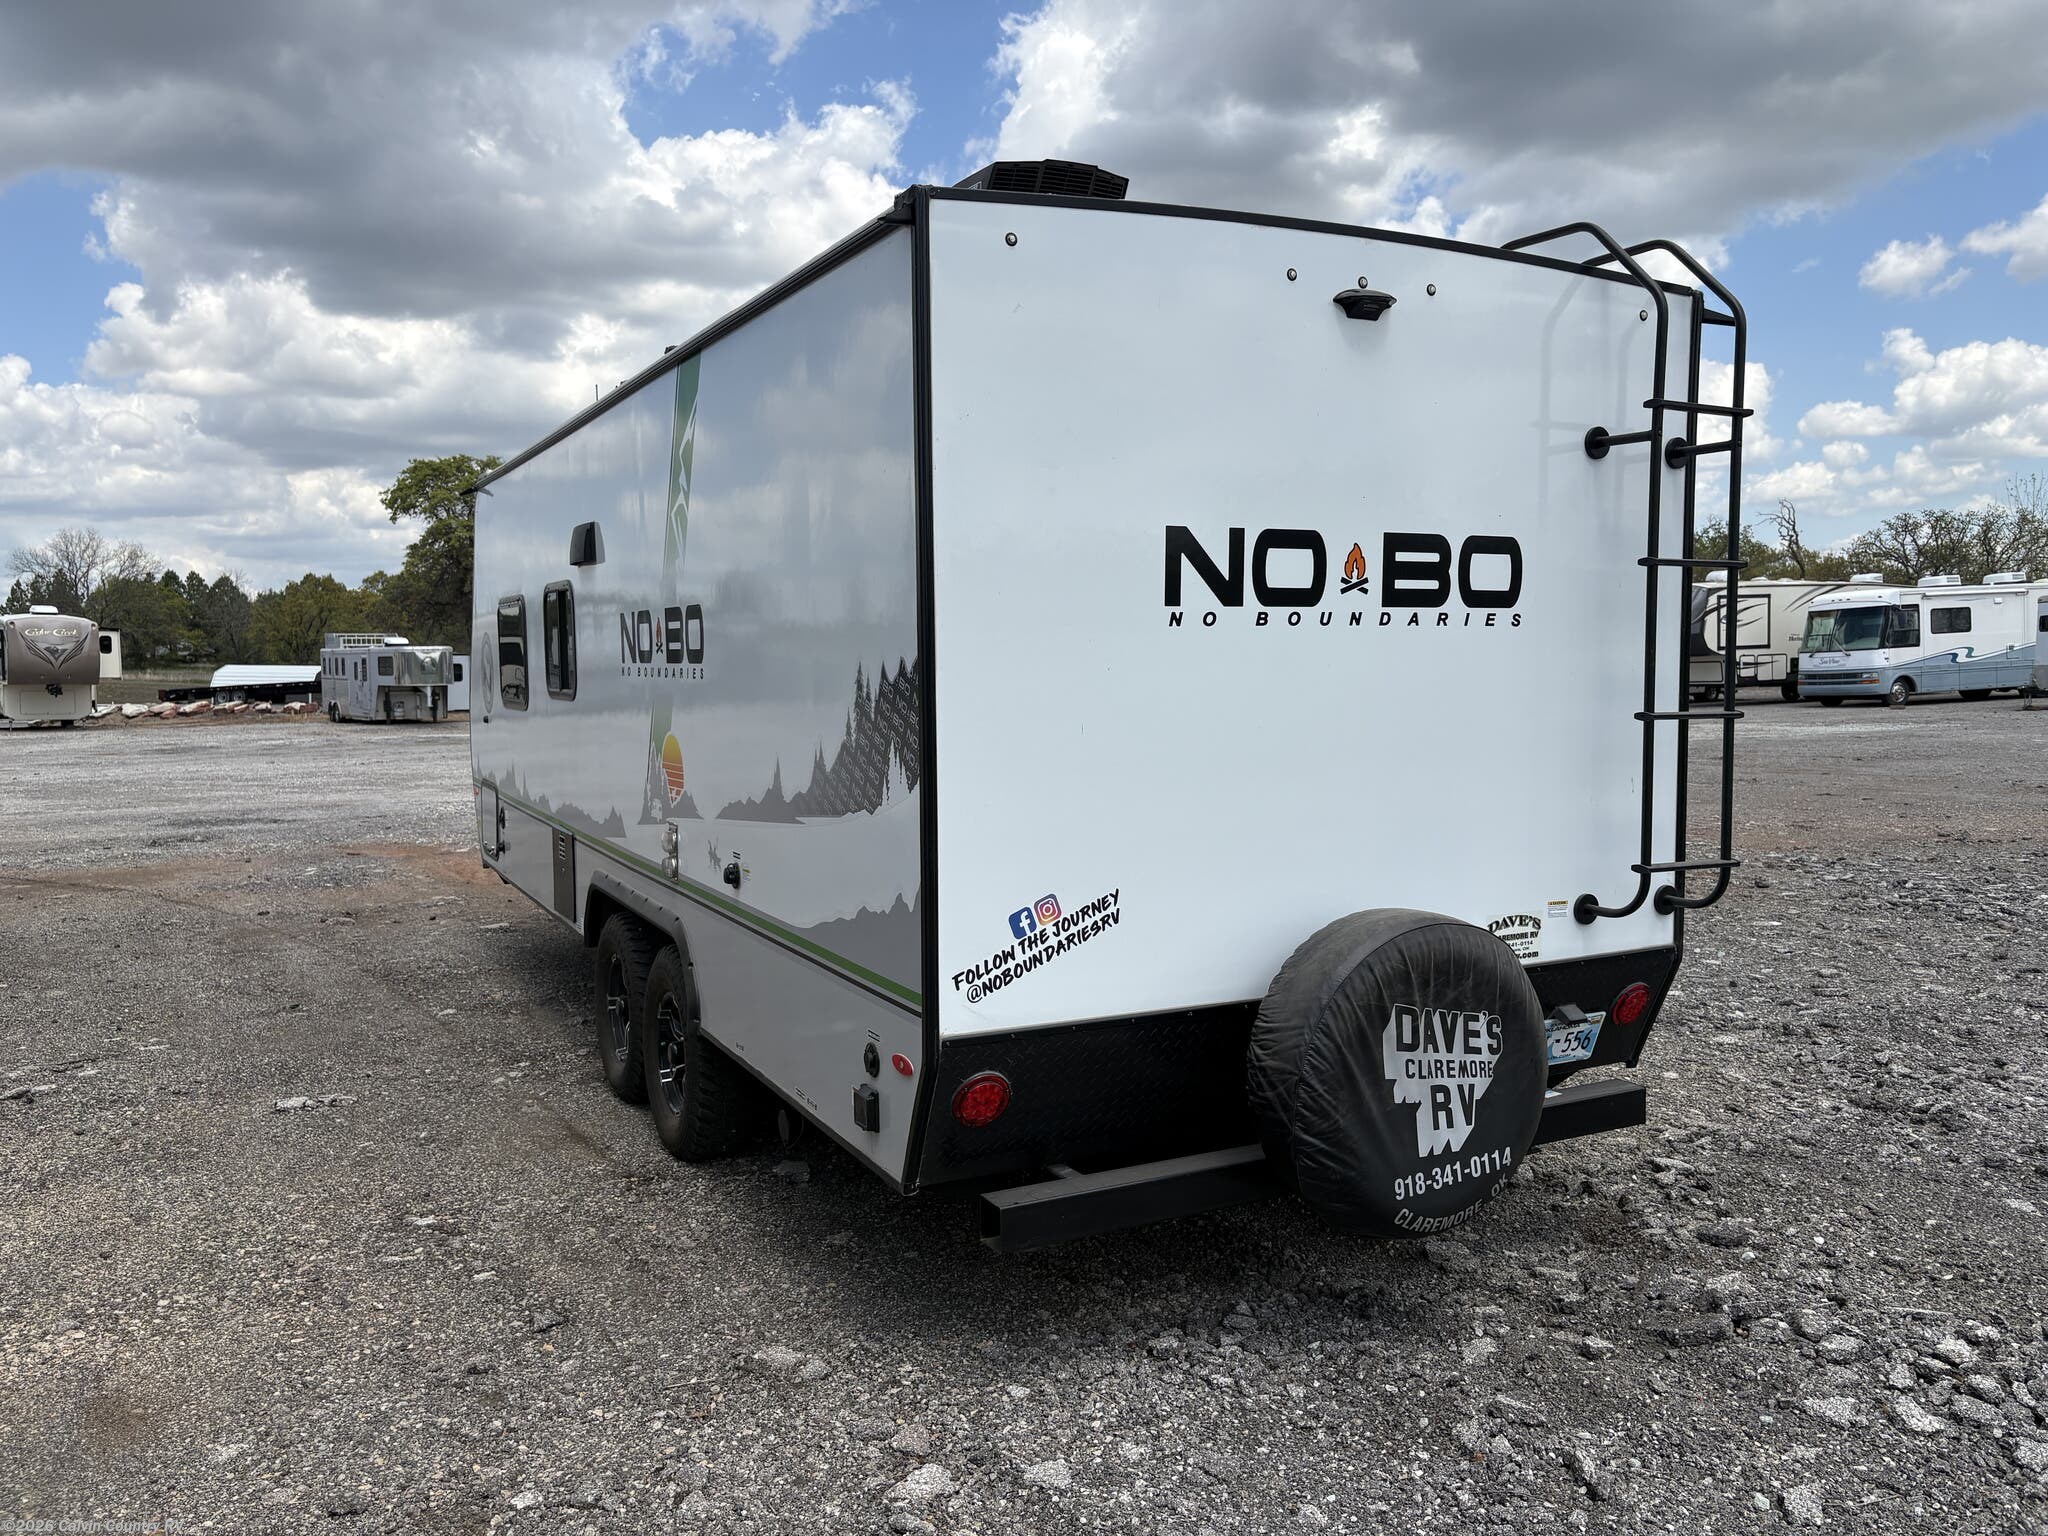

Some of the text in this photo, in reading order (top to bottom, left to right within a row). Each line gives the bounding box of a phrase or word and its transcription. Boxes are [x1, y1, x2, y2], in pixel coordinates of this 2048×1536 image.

[1168, 611, 1523, 628] NO BOUNDARIES
[621, 666, 704, 680] NO BOUNDARIES
[1487, 914, 1541, 933] DAVE'S
[1498, 930, 1539, 941] AREMORE RV
[951, 888, 1121, 992] FOLLOW THE JOURNEY
[966, 908, 1121, 1004] @NOBOUNDARIESRV
[1516, 951, 1539, 959] v.com
[1393, 1004, 1503, 1056] DAVE'S
[1546, 1029, 1594, 1053] -556
[1405, 1059, 1494, 1080] CLAREMORE
[1430, 1083, 1476, 1131] RV
[1394, 1146, 1512, 1201] 918-341-0114
[1394, 1199, 1483, 1233] CLAREMORE
